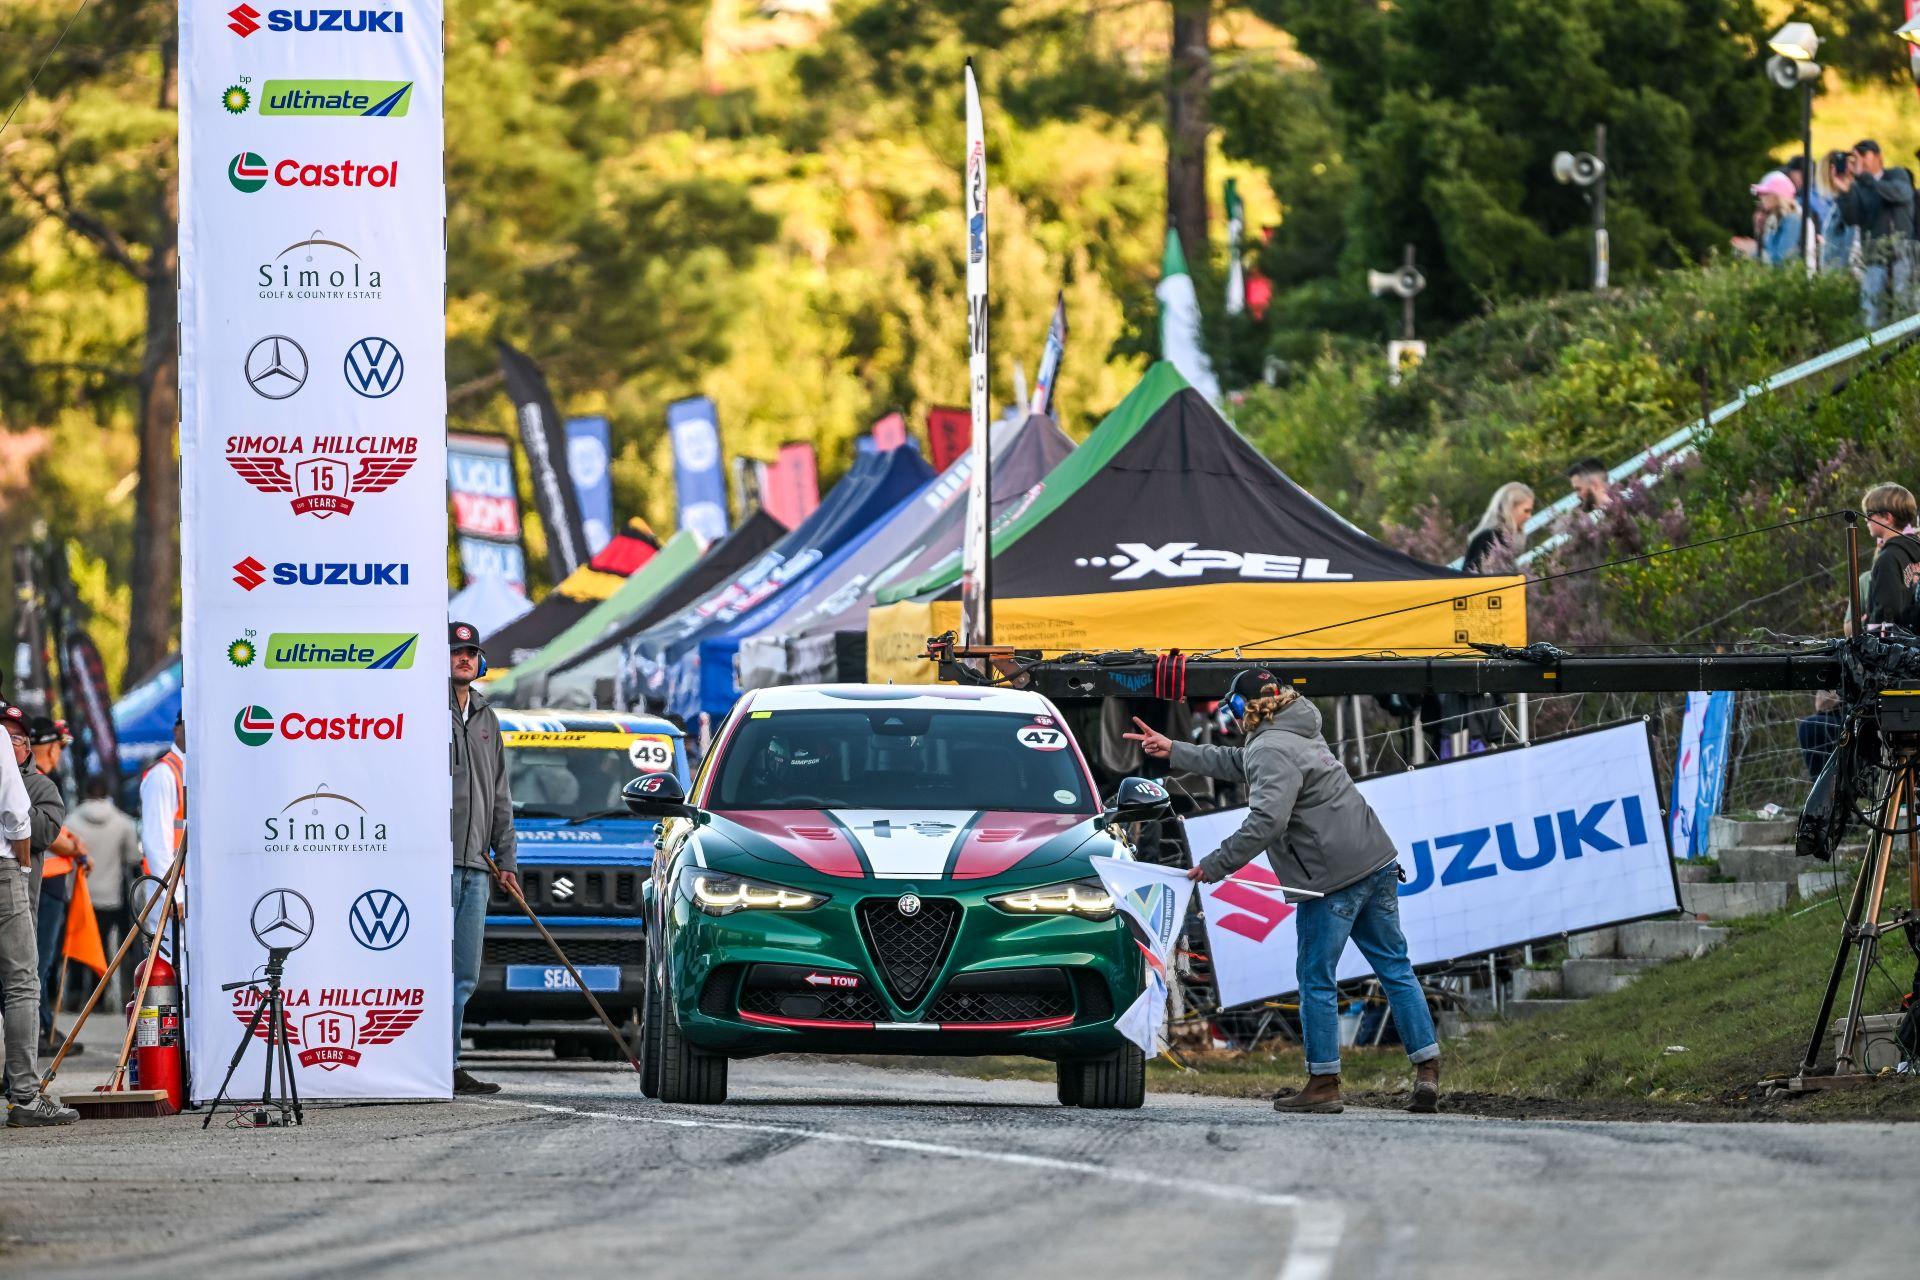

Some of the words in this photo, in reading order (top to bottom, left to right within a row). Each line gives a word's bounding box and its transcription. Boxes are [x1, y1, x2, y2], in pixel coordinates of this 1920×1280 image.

[268, 10, 403, 32] SUZUKI
[240, 75, 251, 84] bp
[270, 90, 369, 109] ultimate
[274, 159, 397, 187] Castrol
[259, 263, 381, 287] Simola
[259, 291, 285, 299] GOLF
[288, 291, 294, 299] &
[297, 291, 344, 299] COUNTRY
[348, 291, 382, 299] ESTATE
[226, 436, 303, 453] SIMOLA
[312, 437, 418, 454] HILLCLIMB
[311, 466, 333, 491] 15
[308, 498, 337, 508] YEARS
[1110, 542, 1353, 580] XPEL
[273, 563, 409, 585] SUZUKI
[1048, 619, 1075, 627] Films
[245, 628, 257, 637] bp
[275, 644, 375, 662] ultimate
[1107, 672, 1153, 692] TRIANGL
[280, 712, 404, 740] Castrol
[1024, 732, 1058, 744] 47
[635, 746, 667, 763] 49
[264, 816, 387, 840] Simola
[264, 844, 290, 852] GOLF
[293, 844, 300, 852] &
[303, 844, 350, 852] COUNTRY
[353, 844, 387, 852] ESTATE
[1397, 795, 1648, 897] UZUKI
[832, 977, 858, 987] TOW
[319, 988, 424, 1006] HILLCLIMB
[318, 1019, 341, 1043] 15
[316, 1051, 344, 1060] YEARS
